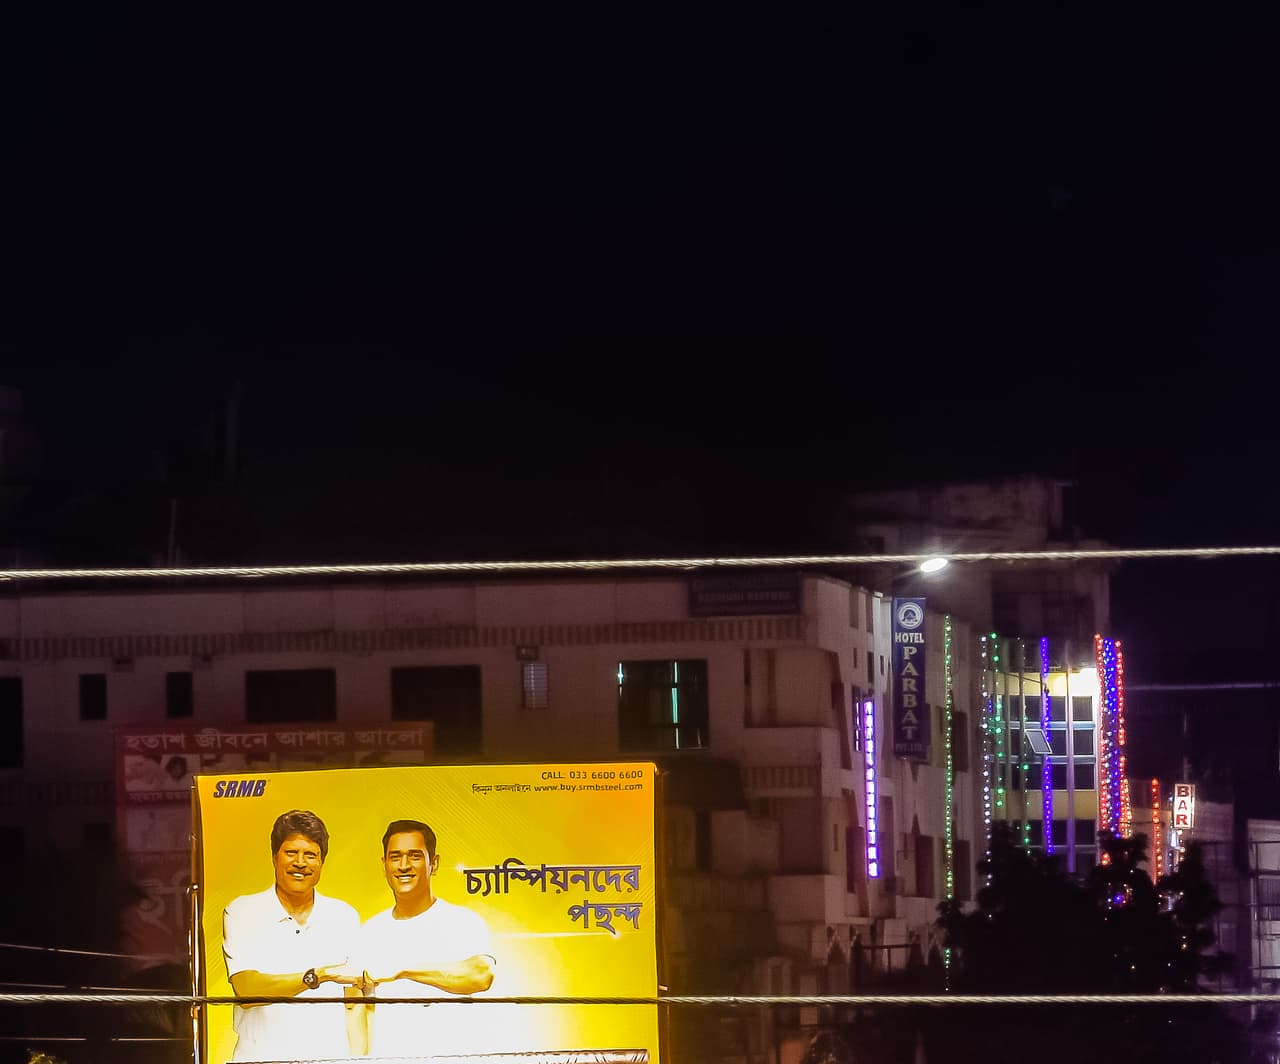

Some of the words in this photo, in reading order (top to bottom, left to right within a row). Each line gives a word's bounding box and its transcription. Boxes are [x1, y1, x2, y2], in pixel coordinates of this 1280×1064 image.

[895, 632, 925, 644] HOTEL
[901, 646, 919, 740] PARBAT
[213, 779, 266, 798] SRMB
[533, 782, 643, 793] www.buy.srmbsteel.com
[569, 771, 587, 779] 033
[591, 771, 616, 780] 6600
[618, 770, 643, 779] 6600
[1177, 785, 1190, 826] BAR
[463, 857, 642, 897] চ্যাম্পিয়নদের
[567, 899, 643, 935] পছন্দ
